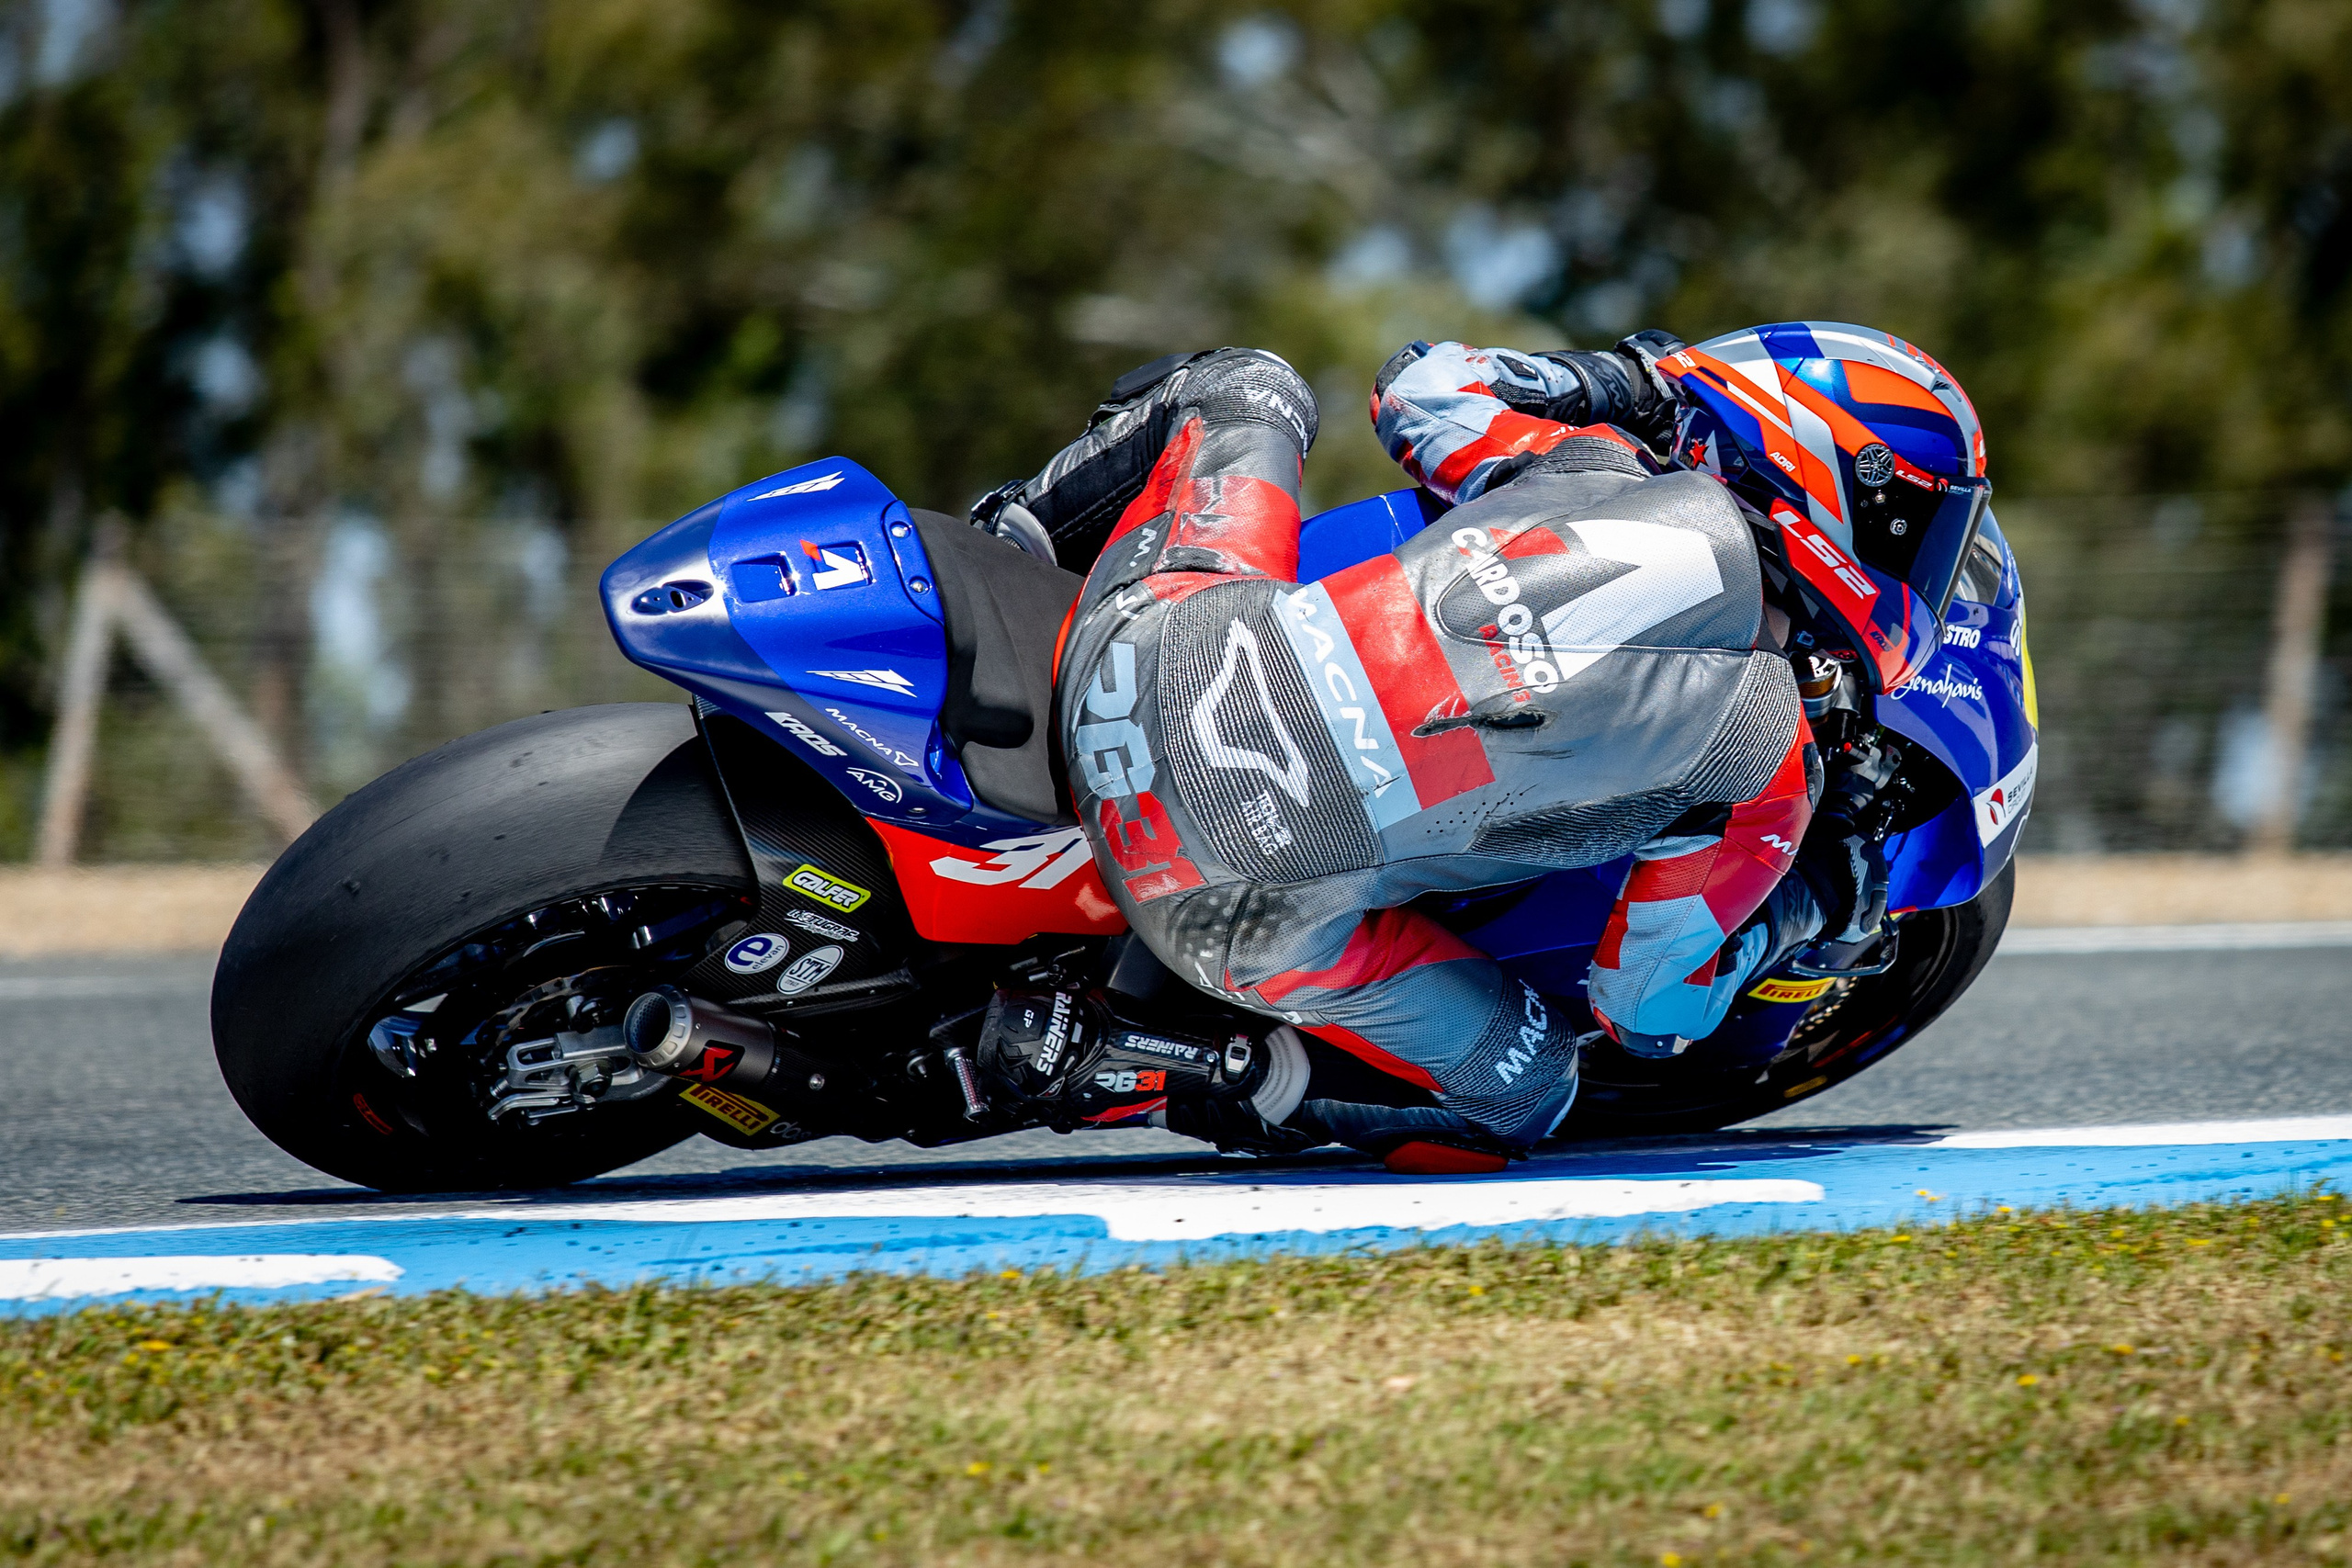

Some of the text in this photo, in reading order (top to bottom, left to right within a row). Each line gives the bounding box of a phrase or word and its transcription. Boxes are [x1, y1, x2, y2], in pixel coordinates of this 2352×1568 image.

[1770, 451, 1796, 473] ADRI
[1894, 469, 1933, 489] LS2
[1949, 484, 1972, 493] SEVILLA
[1772, 510, 1877, 600] LS2
[1451, 527, 1559, 694] CARDOSO
[1942, 624, 1981, 649] STRO
[1478, 624, 1532, 703] RACING
[1288, 588, 1393, 798] MACNA
[825, 707, 892, 756] MACNA
[845, 770, 897, 802] AMG
[929, 826, 1093, 890] 31
[792, 872, 861, 908] GALFER
[752, 943, 786, 971] elevan
[788, 956, 831, 983] STM
[1023, 1009, 1035, 1029] GP
[689, 1084, 770, 1131] PIRELLI
